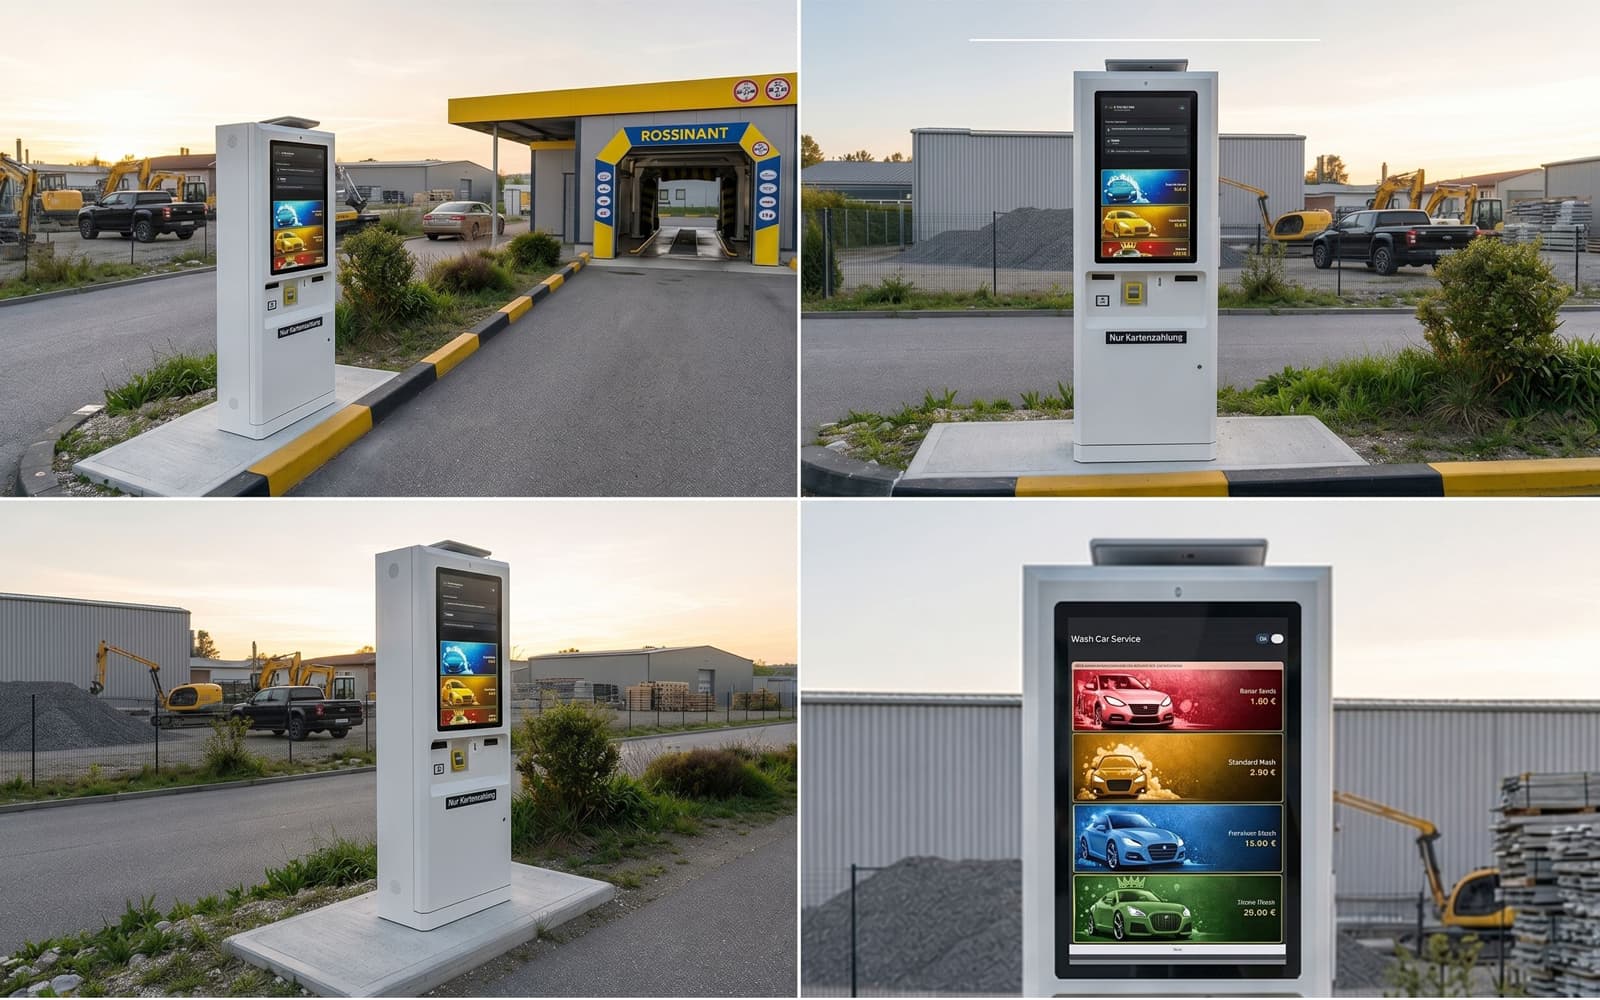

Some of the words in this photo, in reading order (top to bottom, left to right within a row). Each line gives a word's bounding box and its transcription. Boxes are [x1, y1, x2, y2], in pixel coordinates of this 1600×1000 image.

[641, 127, 729, 142] ROSSINANT
[1109, 333, 1125, 342] Nur
[1125, 333, 1183, 343] Kartenzahlung
[1071, 635, 1094, 643] Wash
[1095, 635, 1110, 643] Car
[1111, 635, 1142, 643] Service
[1249, 768, 1269, 776] 2.90
[1270, 768, 1277, 776] €
[447, 798, 460, 807] Nur
[1245, 839, 1269, 847] 15.00
[1270, 839, 1277, 847] €
[1270, 908, 1277, 917] €
